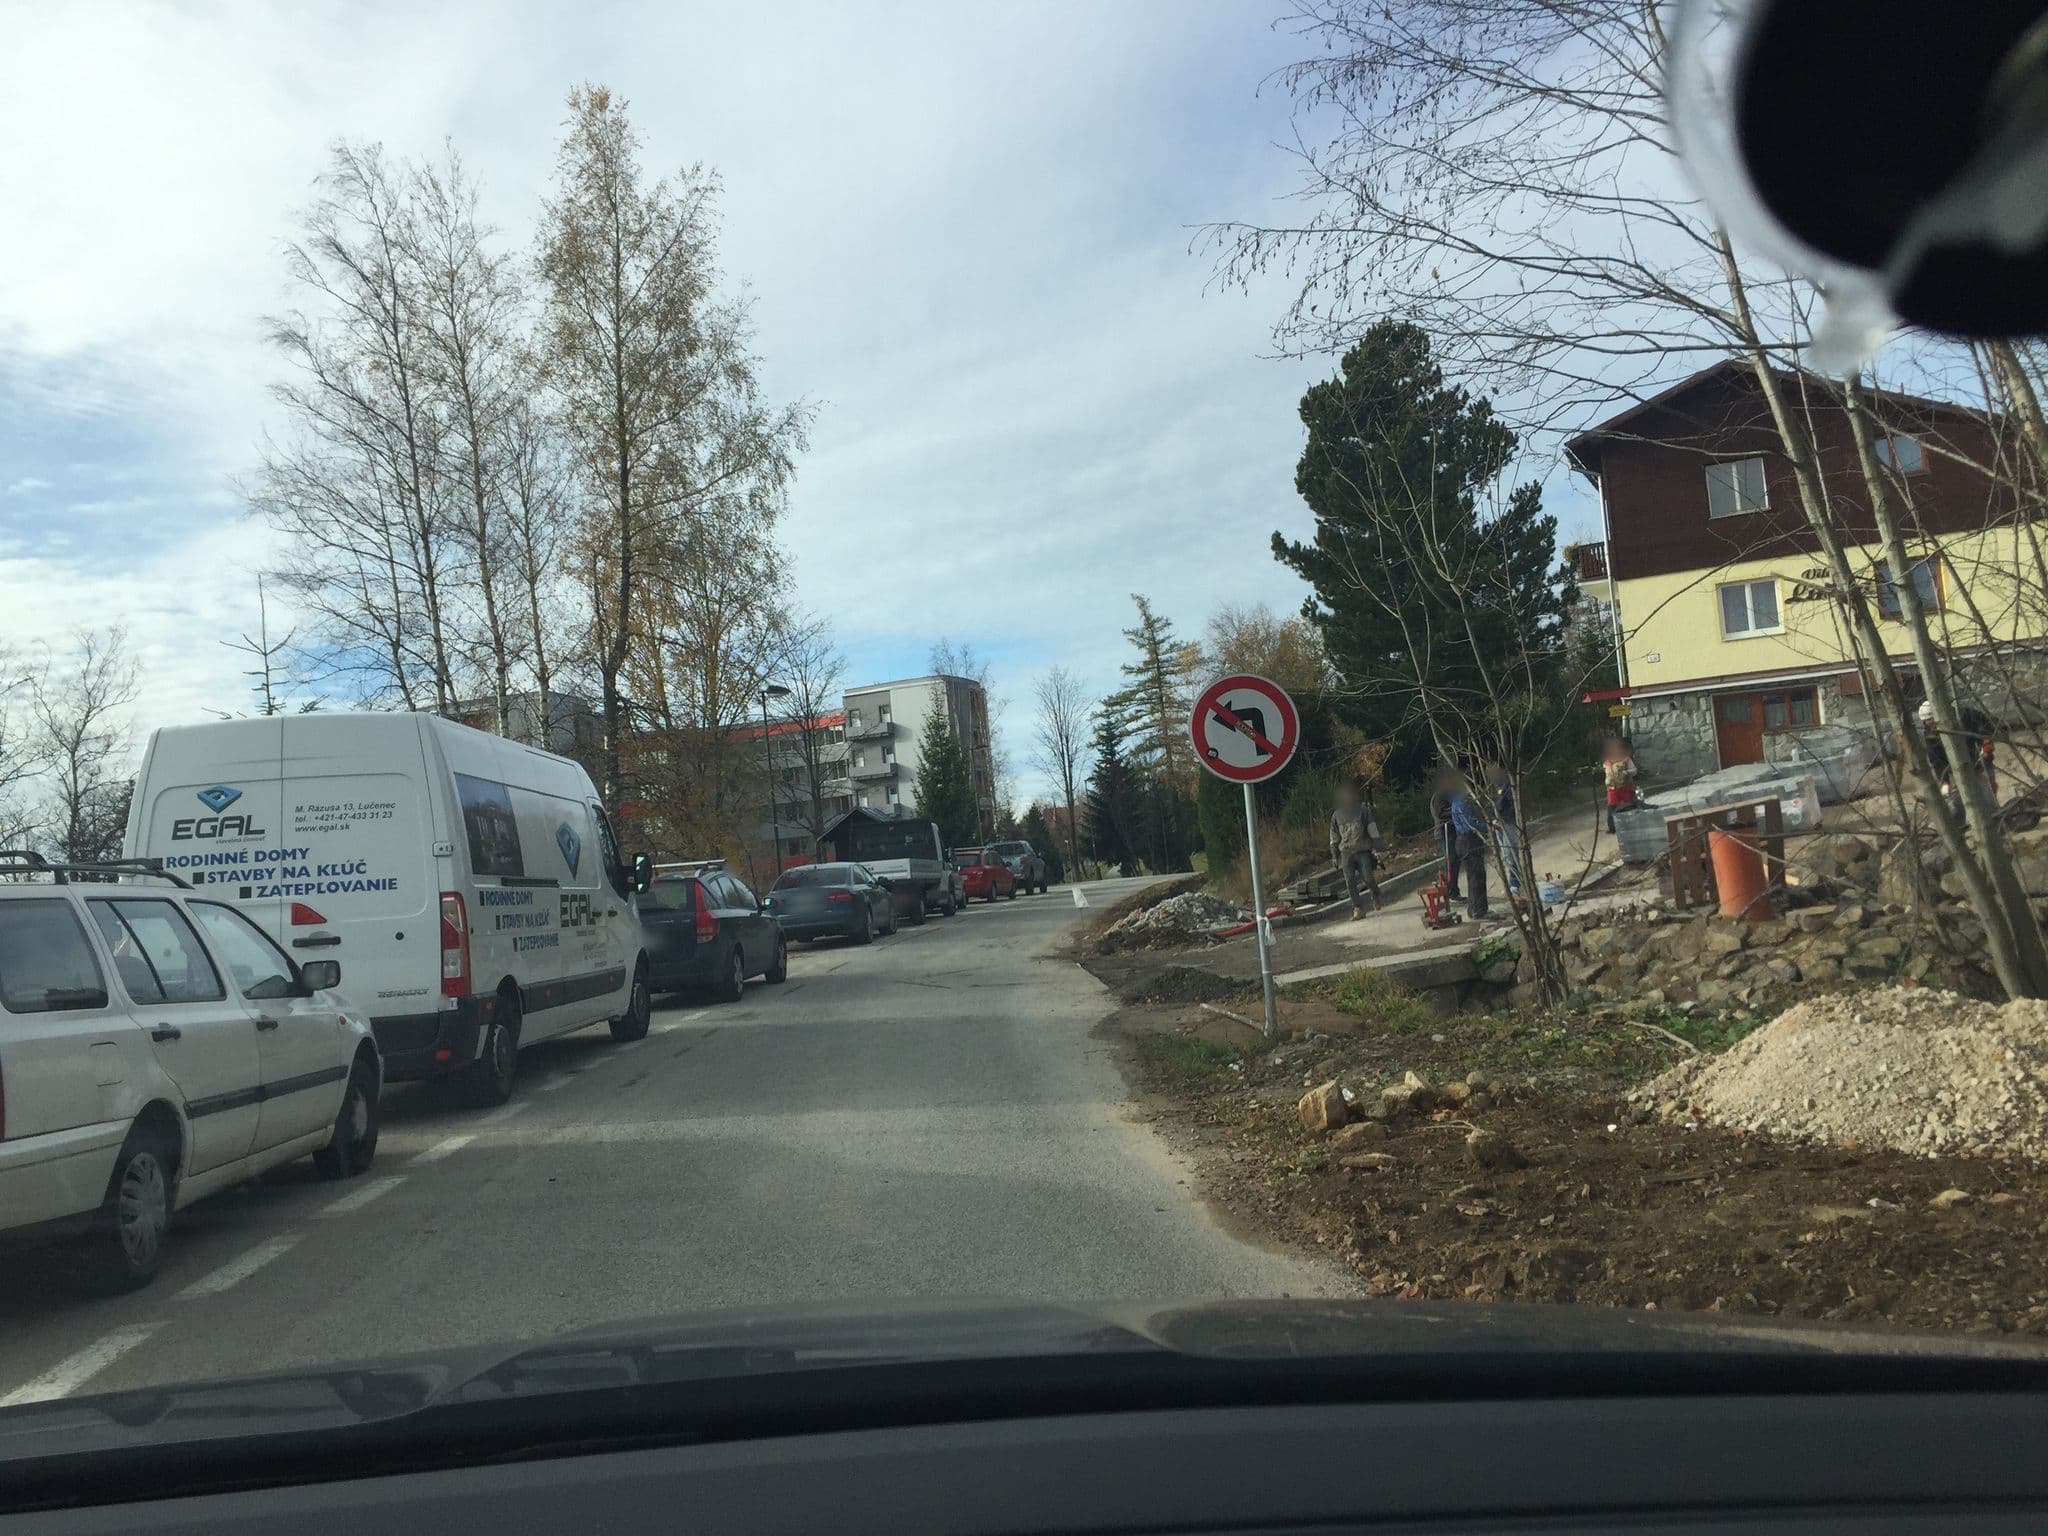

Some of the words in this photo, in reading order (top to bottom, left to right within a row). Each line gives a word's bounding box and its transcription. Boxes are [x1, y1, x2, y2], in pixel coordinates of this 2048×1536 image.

[369, 811, 380, 820] 31
[382, 811, 393, 820] 23
[171, 814, 266, 841] EGAL
[294, 823, 351, 833] www.egal.sk
[166, 848, 249, 869] RODINNÉ
[254, 847, 311, 863] DOMY
[207, 867, 277, 884] STAVBY
[282, 865, 311, 879] NA
[559, 894, 596, 927] EGAL
